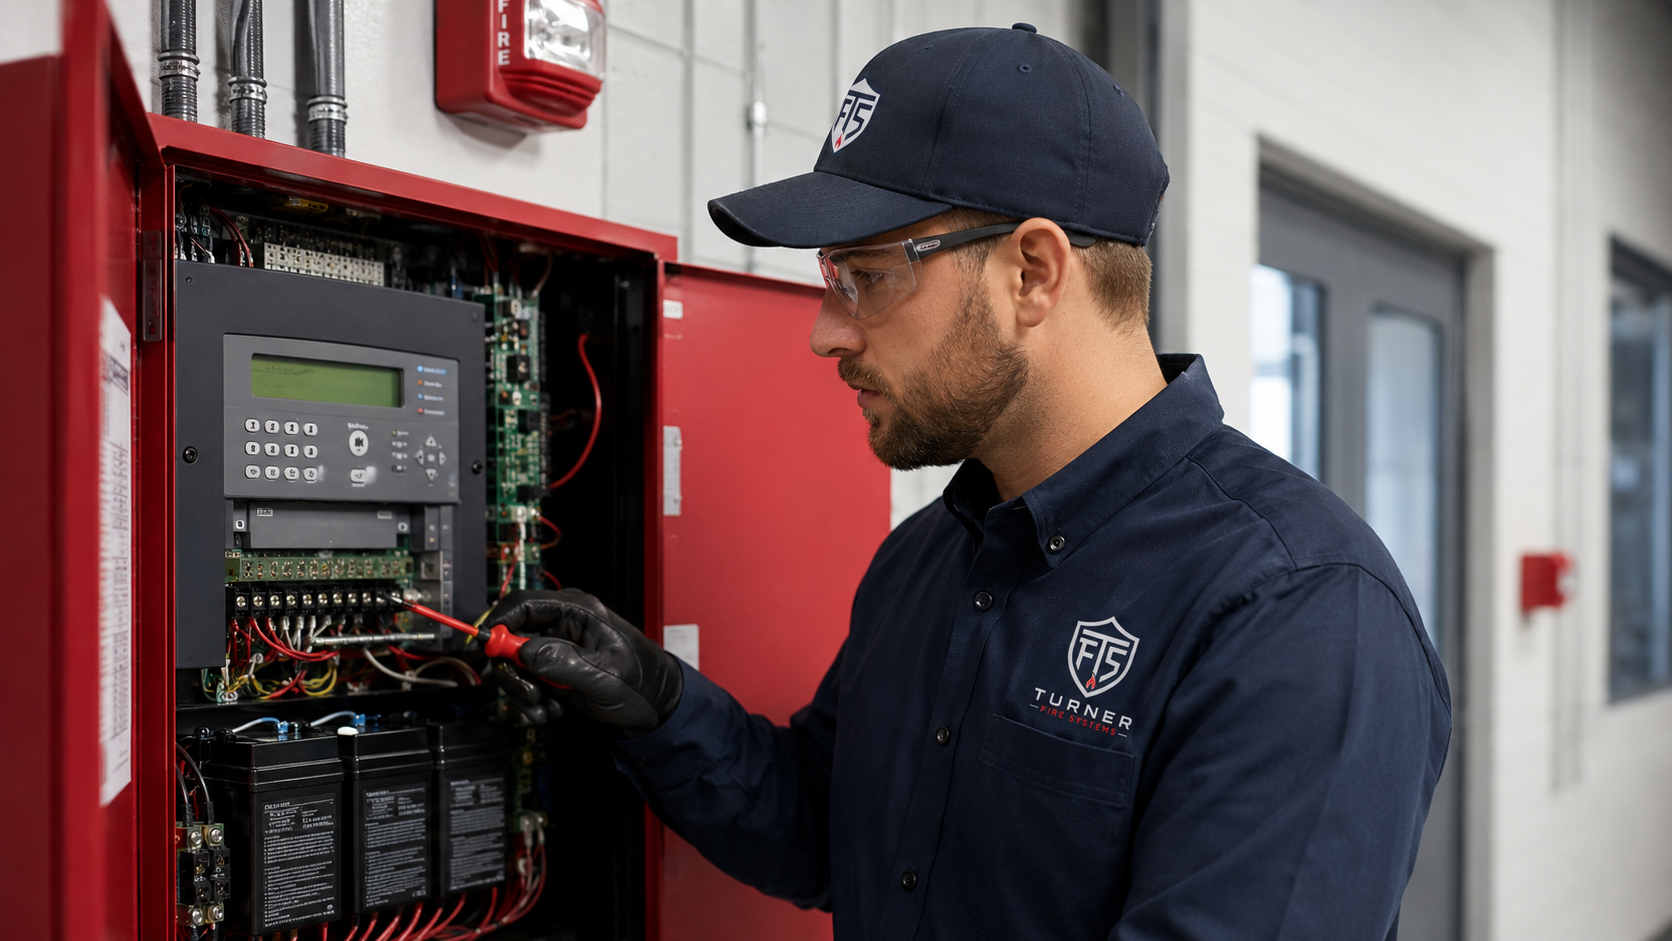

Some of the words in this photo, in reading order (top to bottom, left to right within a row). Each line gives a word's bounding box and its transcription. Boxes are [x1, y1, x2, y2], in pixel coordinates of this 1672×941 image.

[498, 0, 510, 65] FIRE
[1076, 628, 1130, 683] FTS
[1035, 687, 1132, 730] TURNER
[1040, 705, 1064, 719] FIRE
[1069, 714, 1116, 736] SYSTEMS
